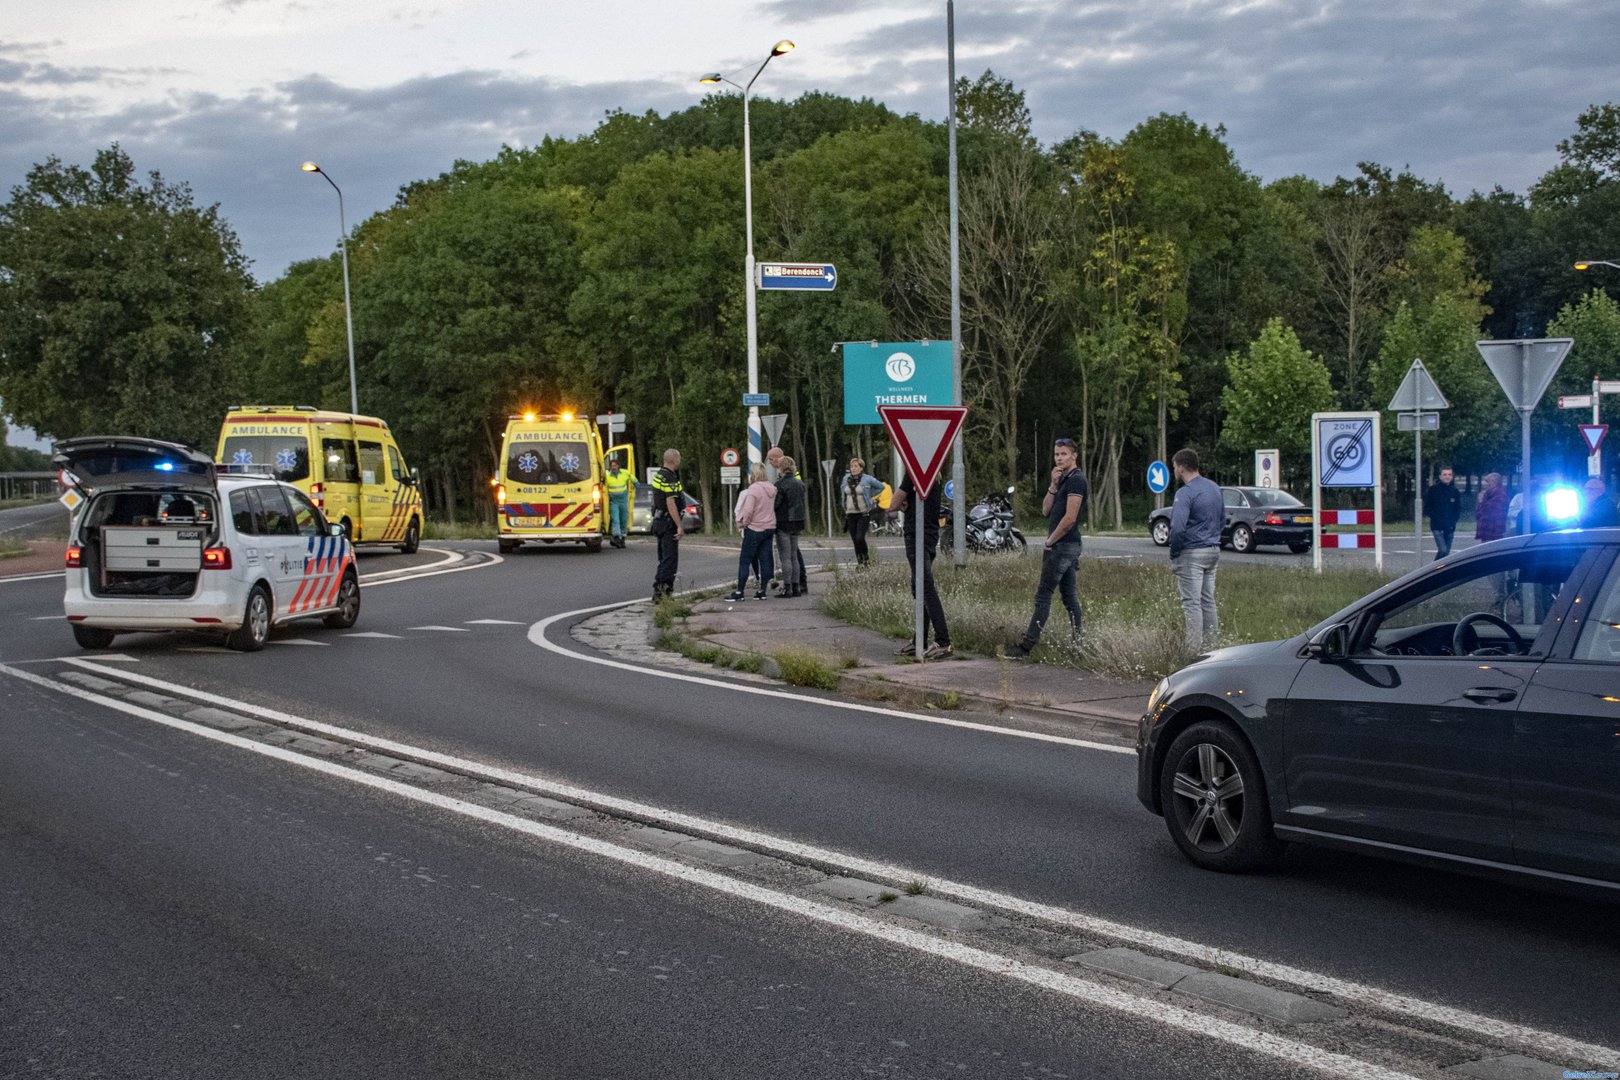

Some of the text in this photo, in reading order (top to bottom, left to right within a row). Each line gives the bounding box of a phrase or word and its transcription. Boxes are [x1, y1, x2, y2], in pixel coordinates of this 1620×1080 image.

[781, 267, 824, 276] Berendonck
[875, 395, 927, 404] THERMEN
[231, 426, 303, 435] AMBULANCE
[1333, 423, 1358, 431] ZONE
[1333, 445, 1359, 460] 60
